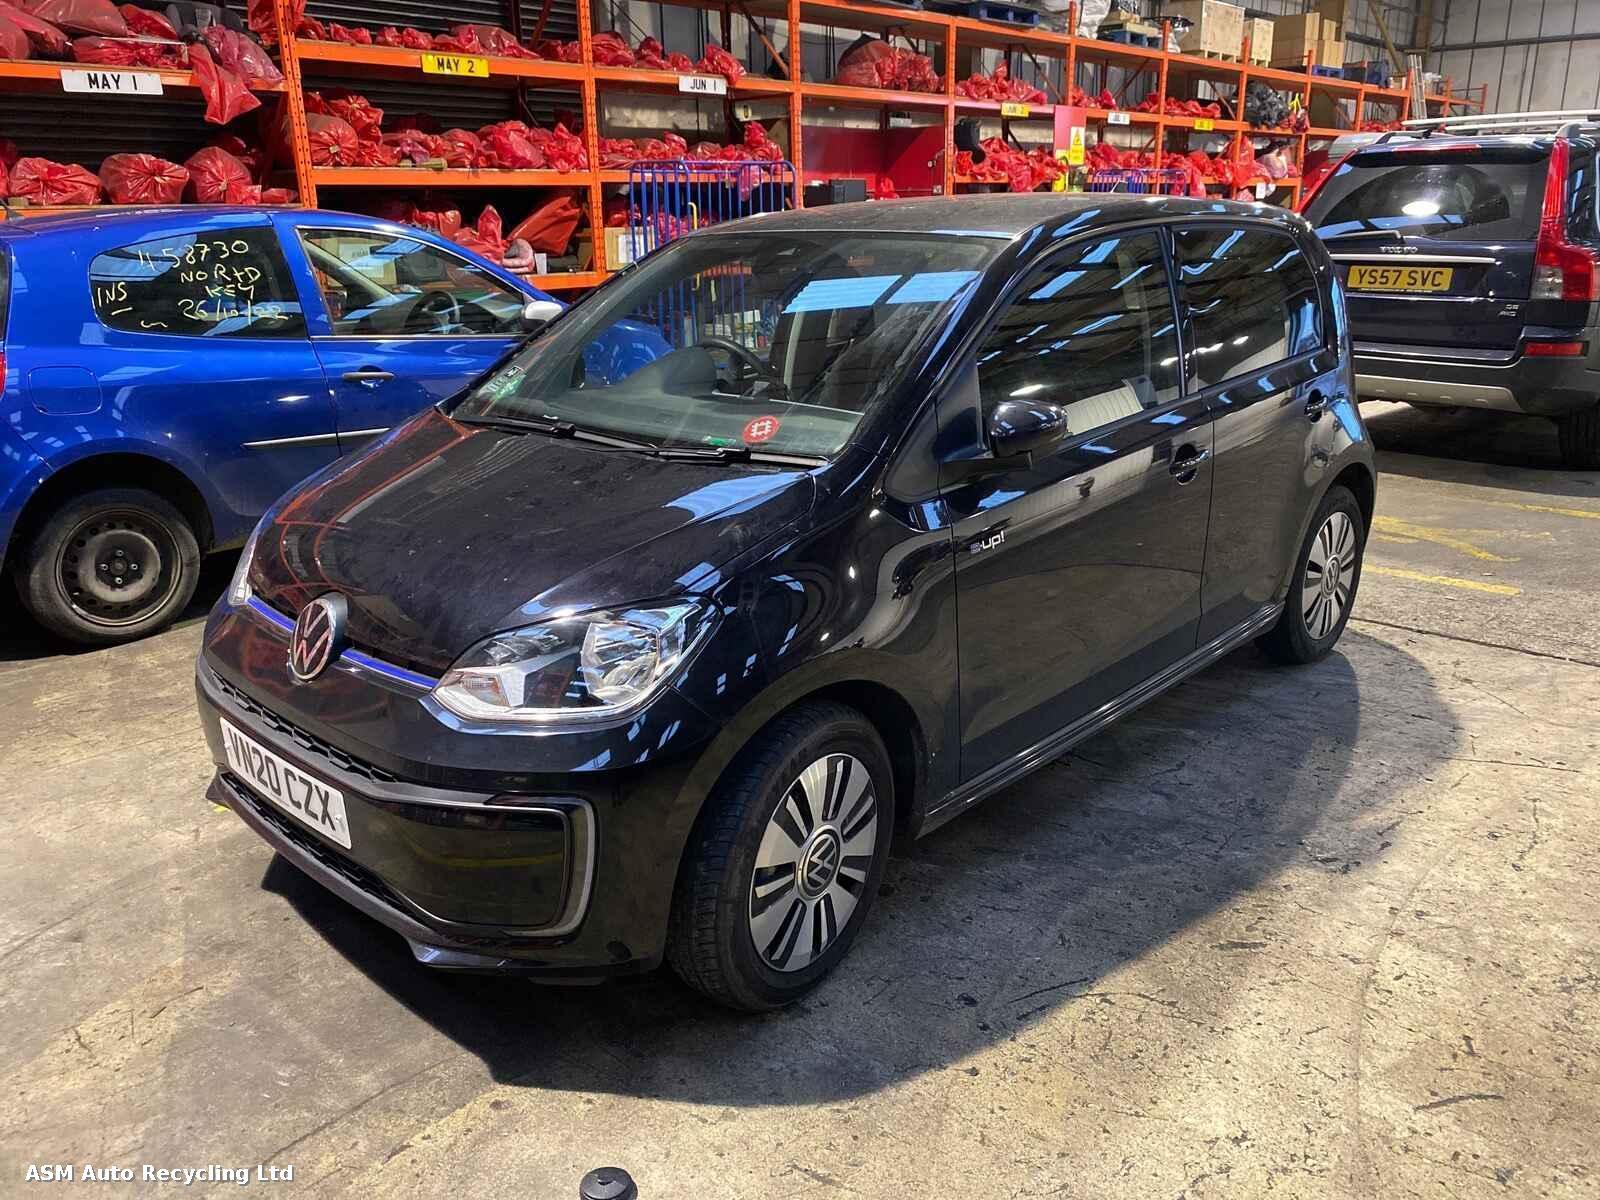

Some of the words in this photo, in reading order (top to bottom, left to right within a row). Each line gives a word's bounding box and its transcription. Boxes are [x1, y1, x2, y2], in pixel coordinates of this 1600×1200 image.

[437, 57, 460, 73] MAY
[467, 60, 475, 73] 2
[87, 73, 121, 90] MAY
[690, 78, 707, 90] JUN
[1358, 269, 1401, 286] YS57
[1407, 270, 1444, 287] SVC
[96, 281, 128, 307] INS
[205, 283, 254, 300] KEY
[283, 767, 336, 831] CZX
